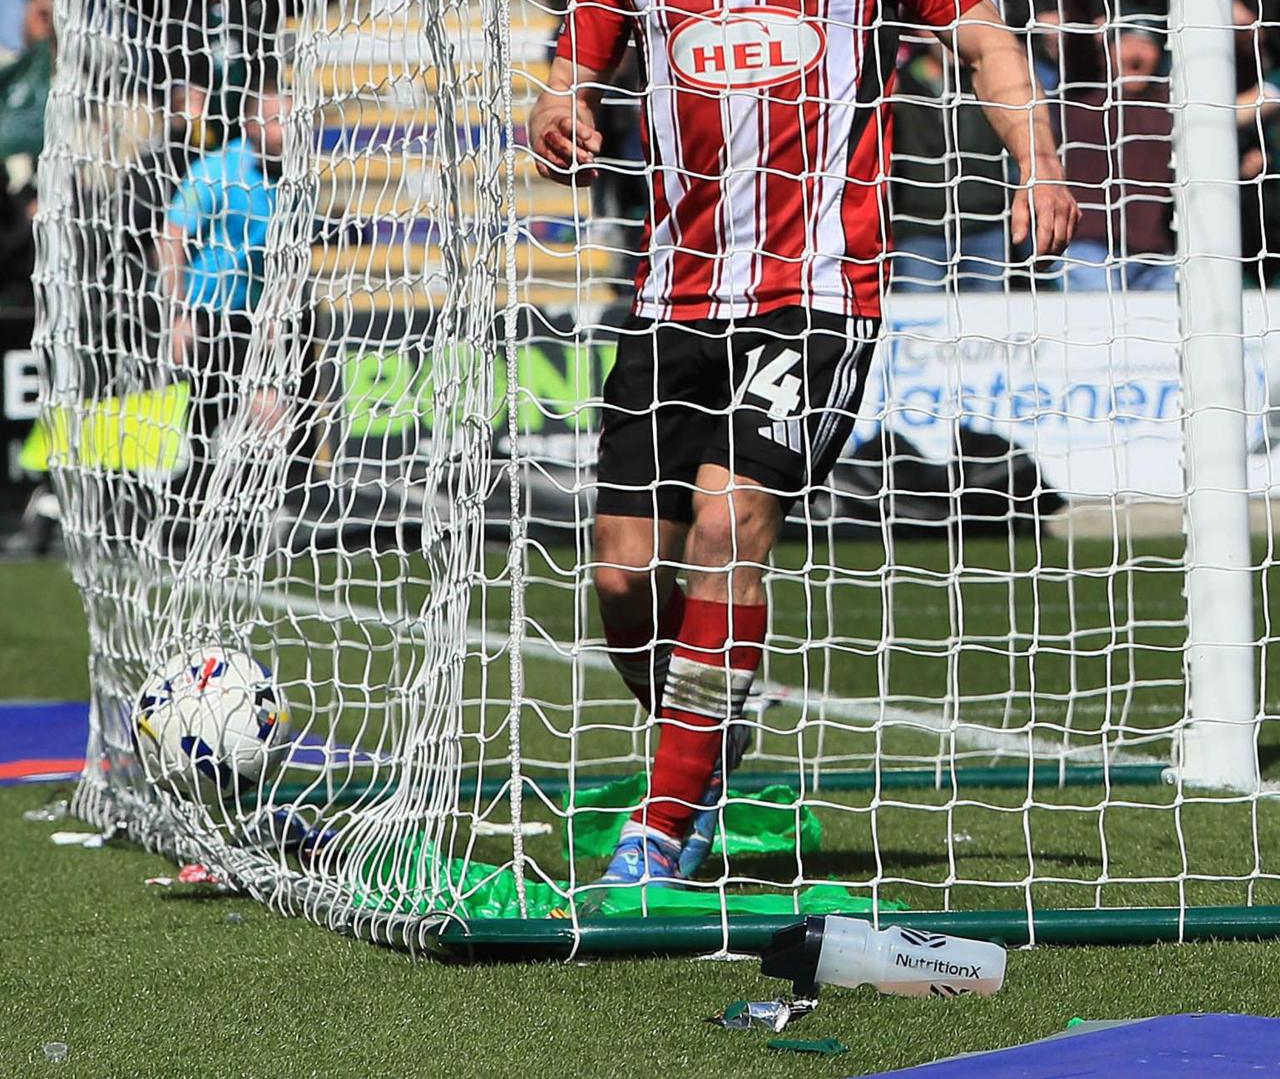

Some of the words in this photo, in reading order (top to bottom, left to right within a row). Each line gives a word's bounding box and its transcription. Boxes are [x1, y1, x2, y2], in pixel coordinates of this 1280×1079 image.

[692, 40, 798, 74] HEL
[732, 344, 803, 420] 14
[894, 952, 983, 980] NutritionX
